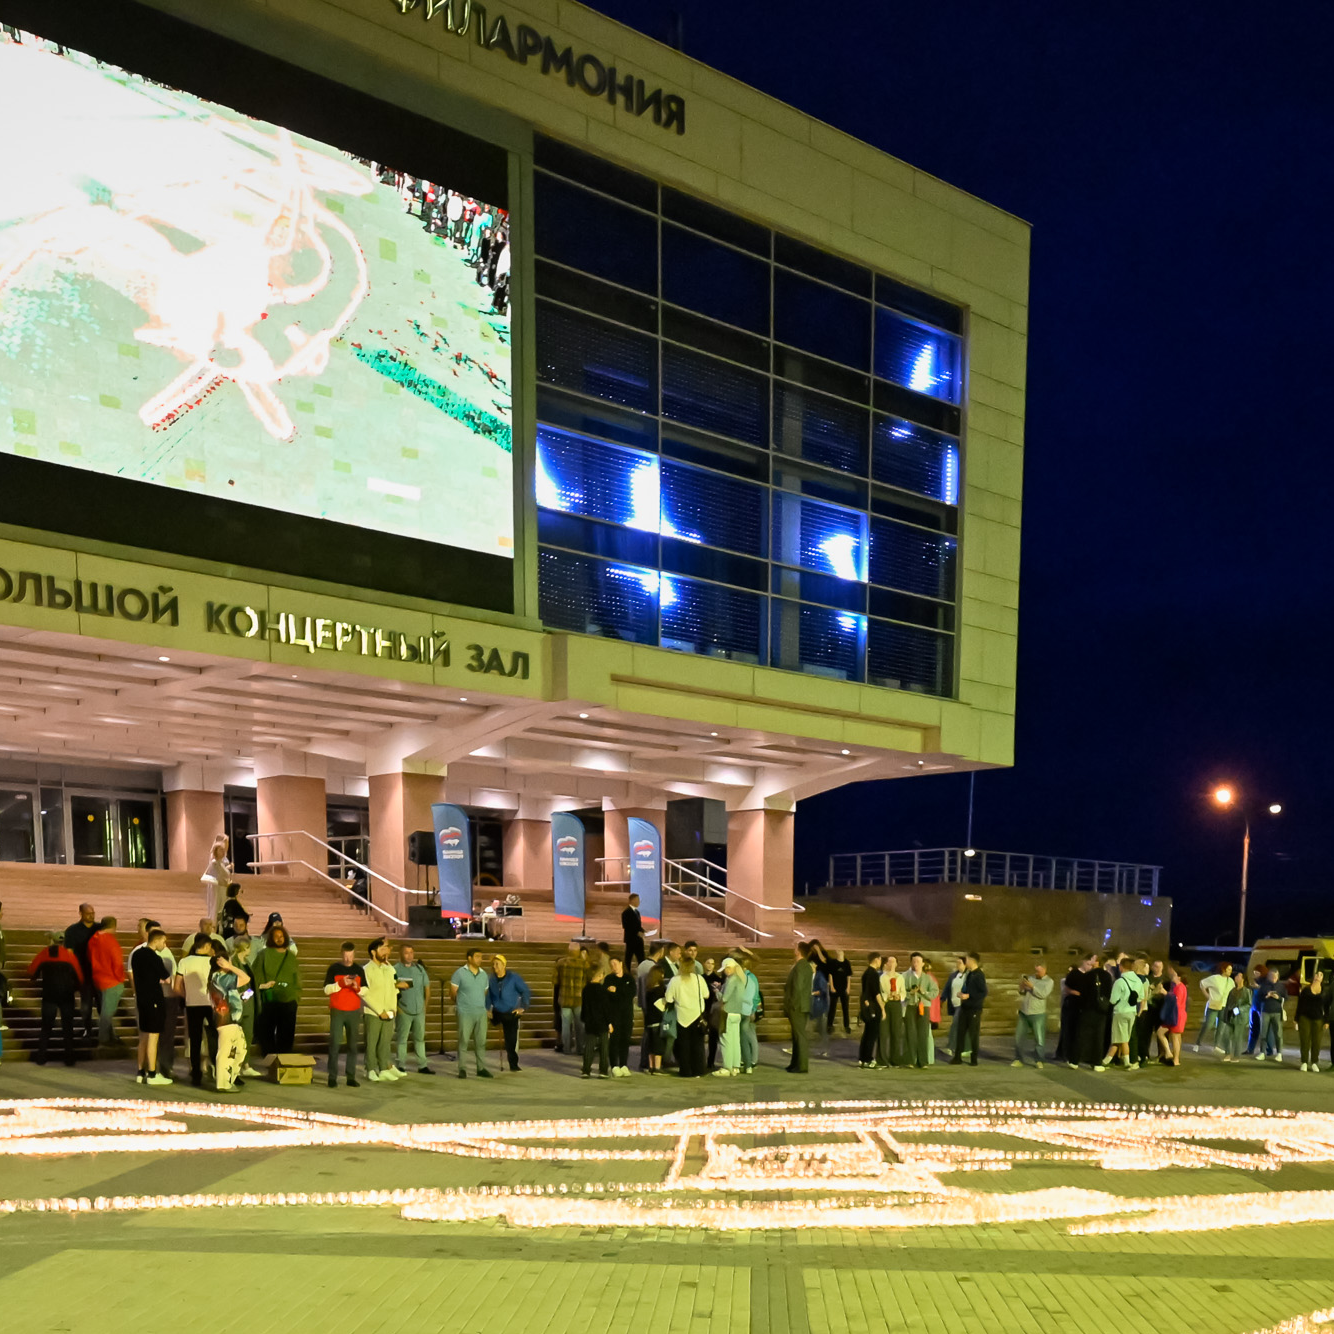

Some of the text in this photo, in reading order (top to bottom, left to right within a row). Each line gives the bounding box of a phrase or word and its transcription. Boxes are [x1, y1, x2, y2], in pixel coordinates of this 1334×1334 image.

[394, 0, 686, 136] ИЛАРМОНИЯ
[205, 600, 451, 668] КОНЦЕРТНЫЙ
[466, 643, 530, 680] ЗАЛ
